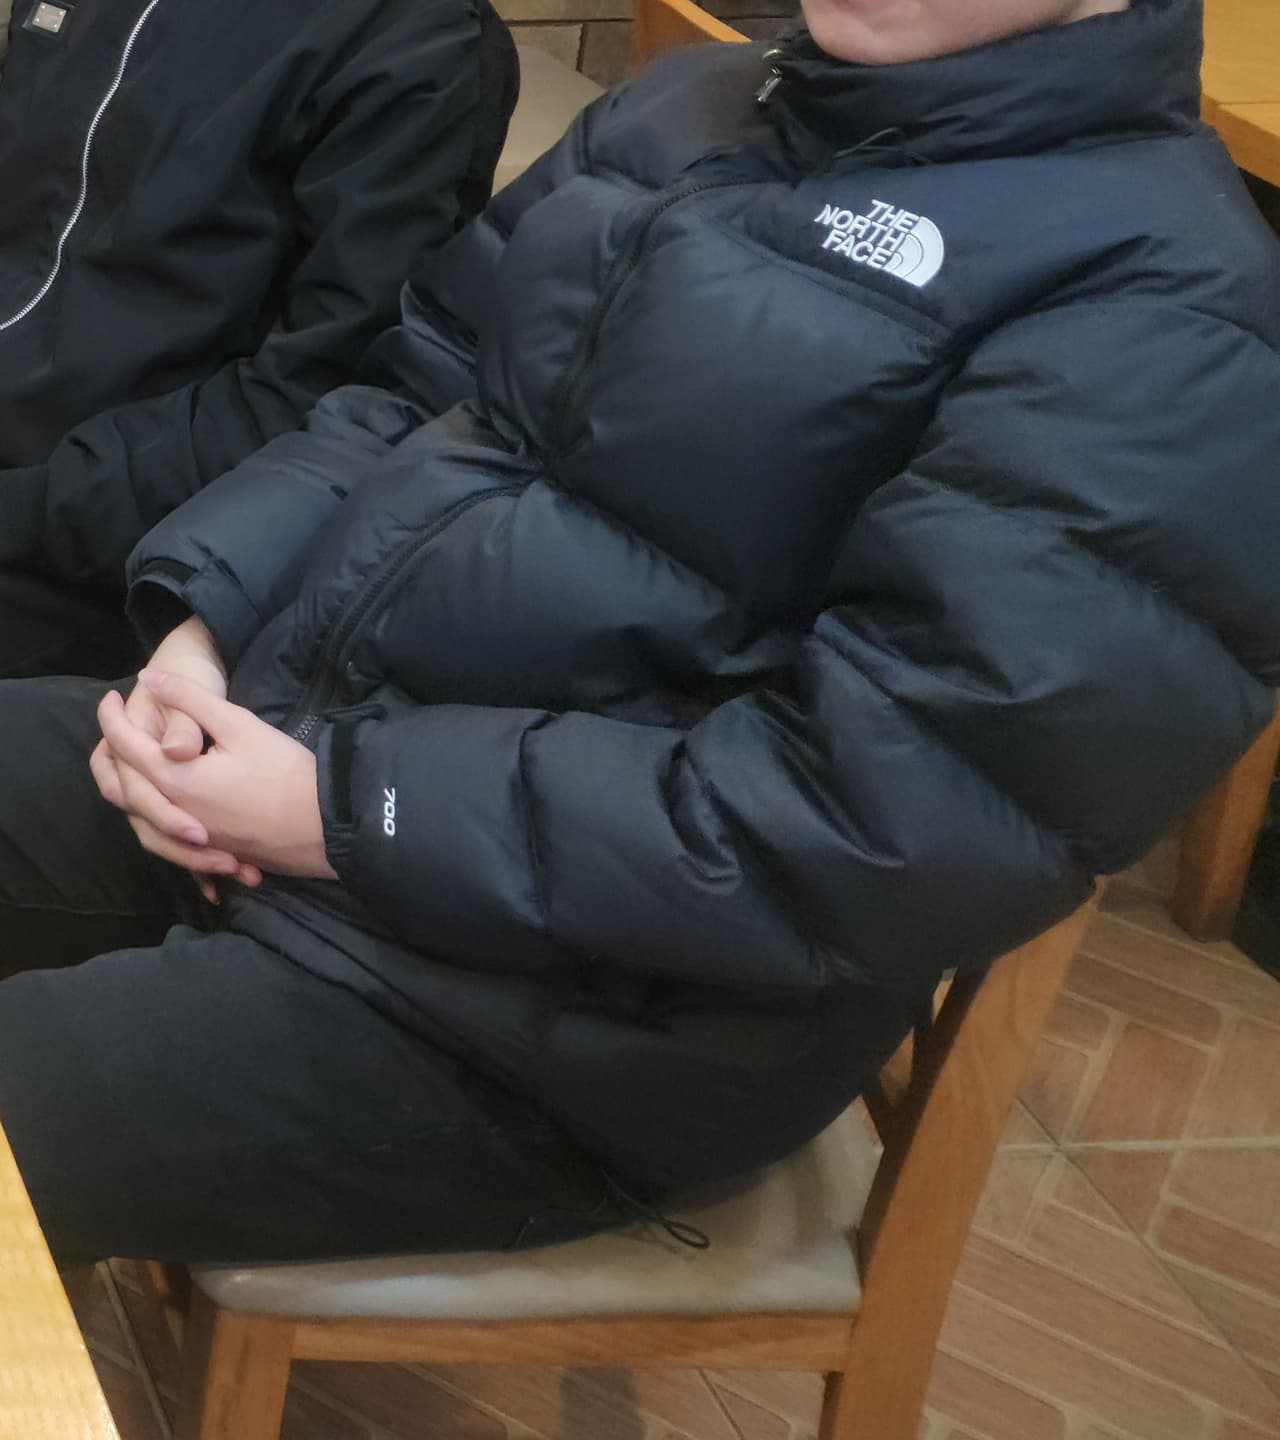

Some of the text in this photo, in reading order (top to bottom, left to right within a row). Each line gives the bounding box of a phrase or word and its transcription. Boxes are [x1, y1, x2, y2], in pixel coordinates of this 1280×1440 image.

[813, 203, 908, 253] NORTH
[866, 199, 920, 233] THE
[822, 229, 894, 271] FACE
[384, 787, 396, 837] 700
